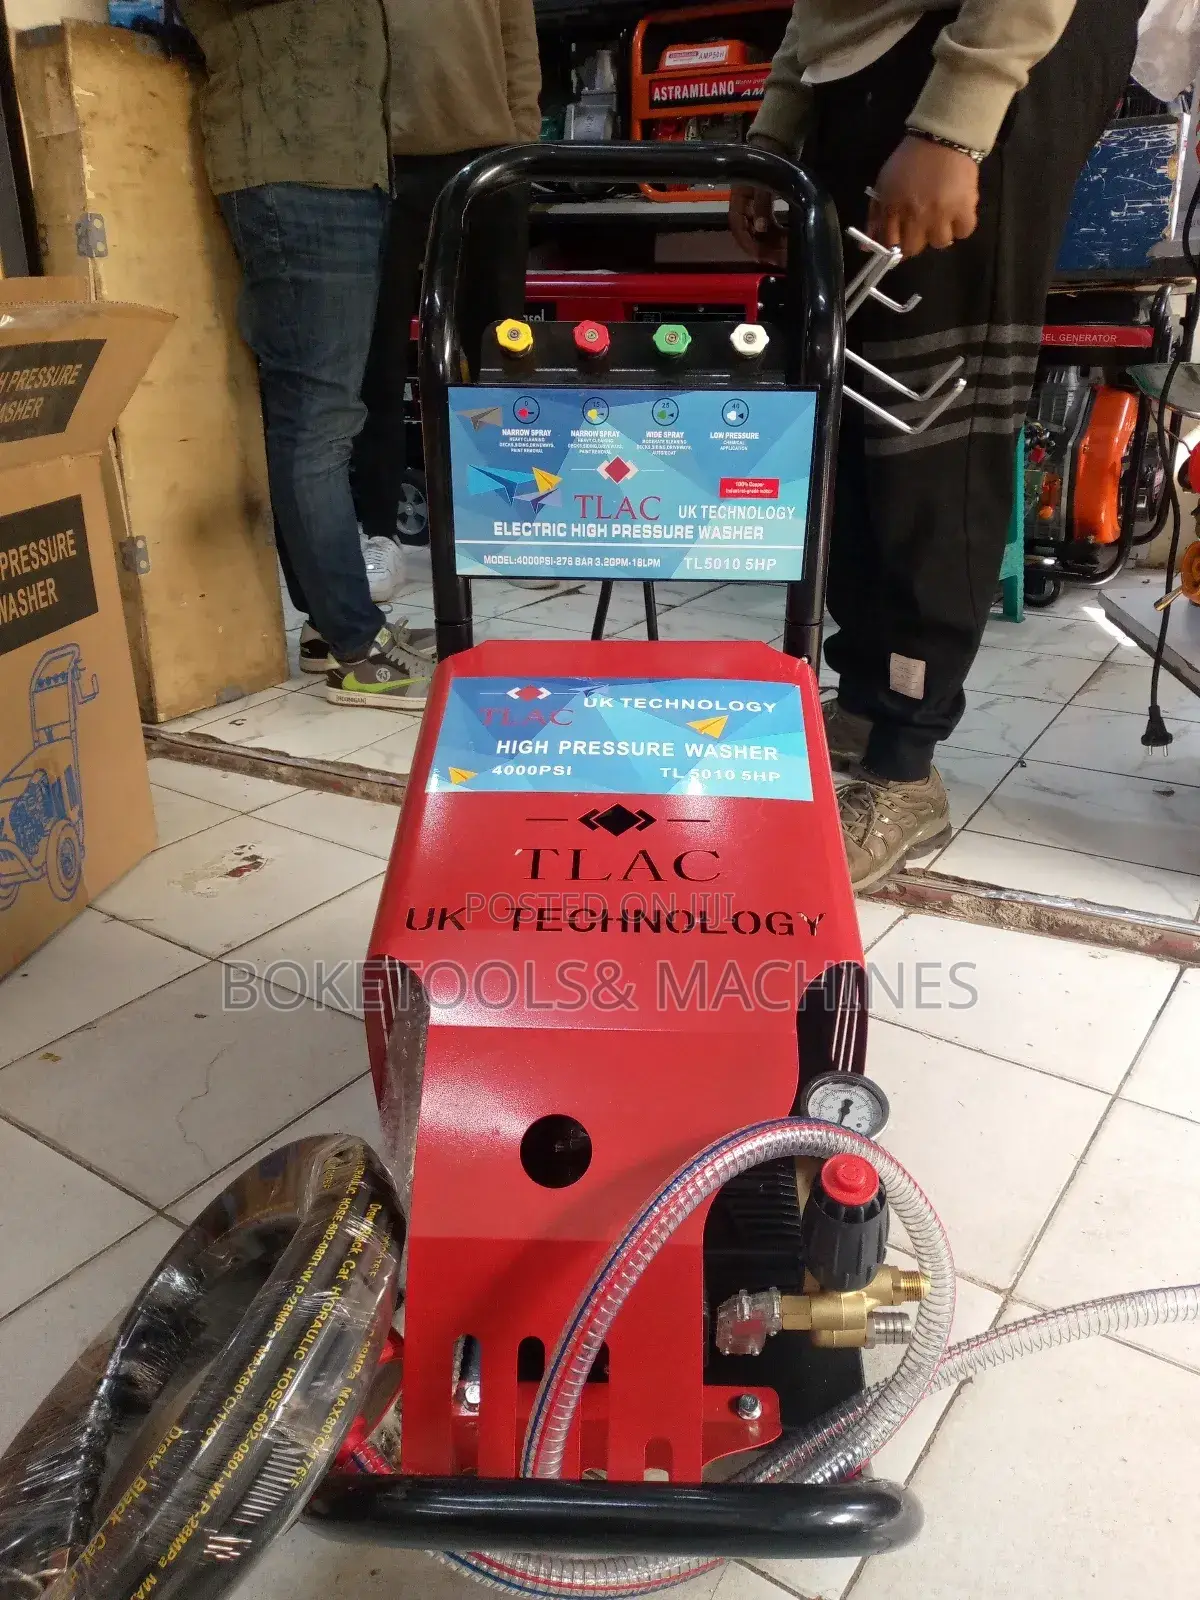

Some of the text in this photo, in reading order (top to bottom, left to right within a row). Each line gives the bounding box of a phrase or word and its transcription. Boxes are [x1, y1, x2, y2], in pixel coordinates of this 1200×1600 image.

[653, 80, 735, 101] ASTRAMILANO
[1058, 333, 1118, 343] GENERATOR
[6, 363, 83, 393] PRESSURE
[502, 428, 552, 437] NARROW SPRAY
[570, 429, 620, 438] NARROW SPRAY
[646, 431, 685, 439] WIDE SPRAY
[710, 432, 760, 440] LOW PRESSURE
[574, 494, 661, 521] TLAC
[678, 504, 795, 520] UK TECHNOLOGY
[493, 521, 764, 541] ELECTRIC HIGH PRESSURE WASHER
[0, 529, 77, 581] PRESSURE
[575, 556, 593, 567] BAR
[684, 557, 777, 571] TL5010 5HP
[583, 697, 777, 713] UK TECHNOLOGY
[479, 706, 574, 727] TLAC
[496, 739, 779, 761] HIGH PRESSURE WASHER
[491, 765, 573, 777] 4000PSI
[660, 767, 781, 782] TL 5010 5HP
[513, 848, 721, 882] TLAC
[405, 906, 827, 937] UK TECHNOLOGY
[149, 1425, 183, 1470] Drew
[109, 1475, 148, 1526] Black
